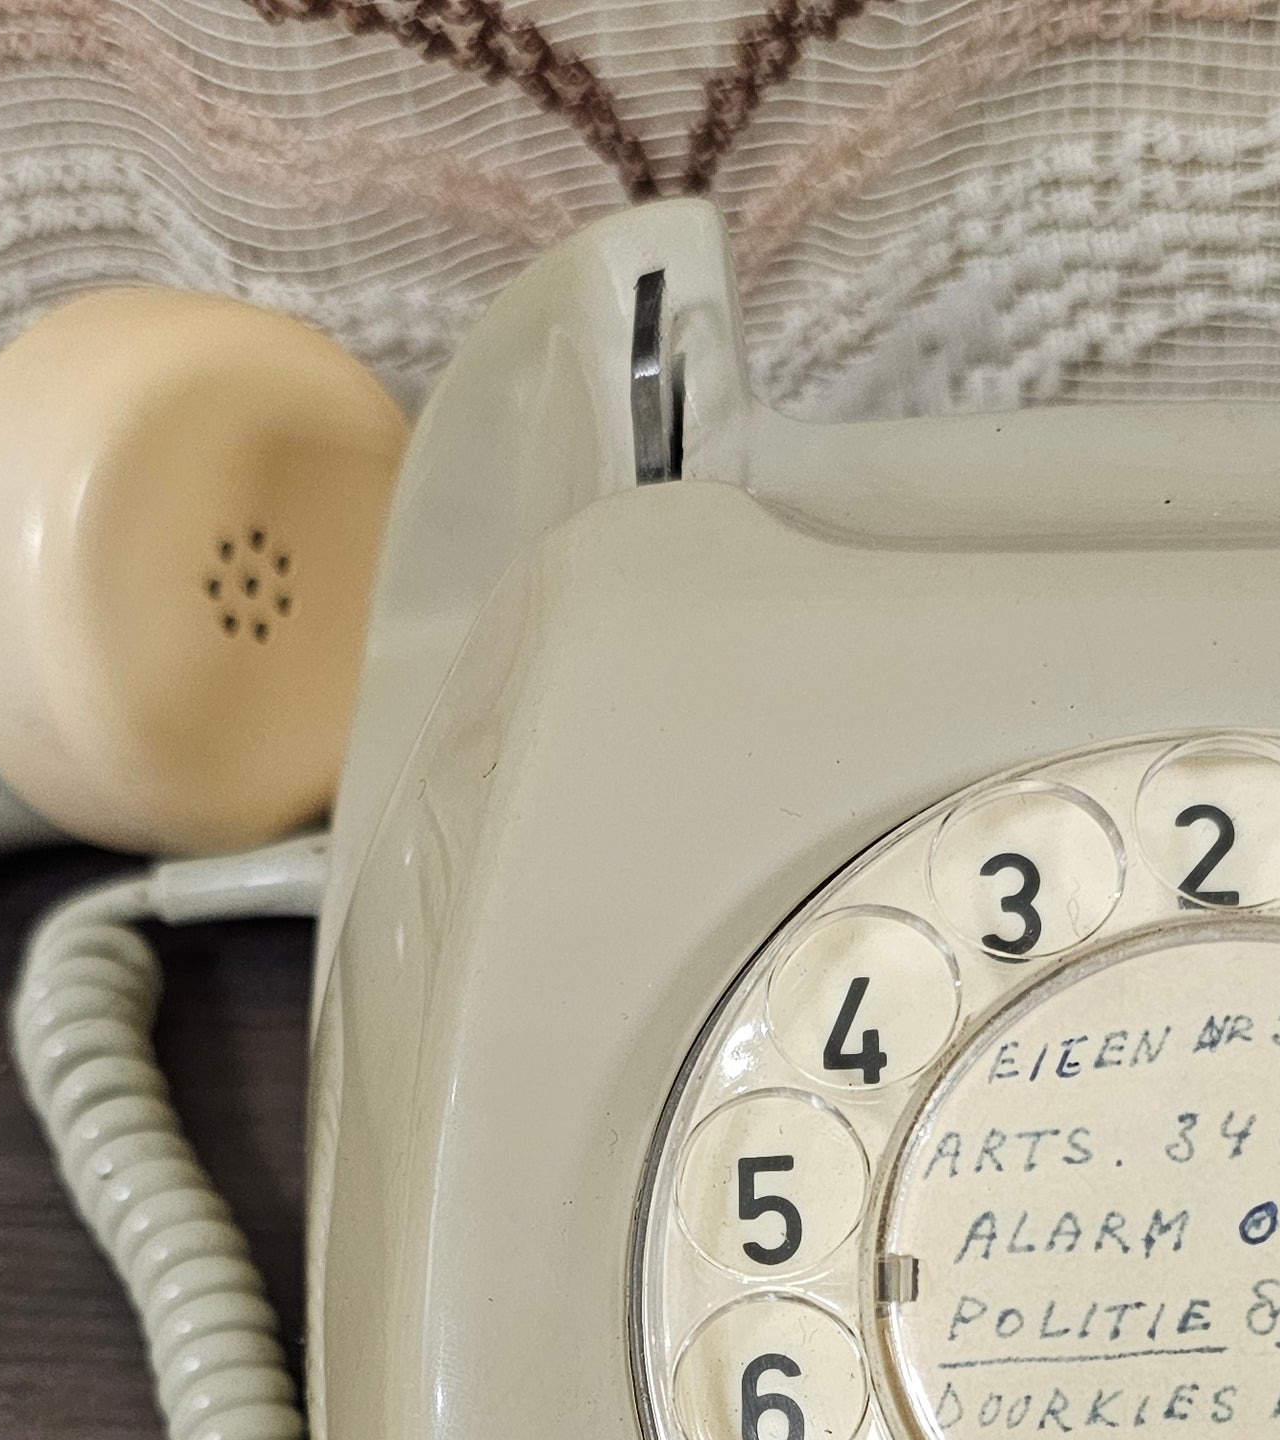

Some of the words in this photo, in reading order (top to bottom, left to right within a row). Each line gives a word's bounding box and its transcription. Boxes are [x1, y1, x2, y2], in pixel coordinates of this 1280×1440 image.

[978, 851, 1043, 957] 3
[1174, 804, 1240, 910] 2
[823, 975, 889, 1086] 4
[737, 1154, 804, 1267] 5
[954, 1208, 1190, 1265] ALARM
[947, 1295, 1212, 1342] POLITIE
